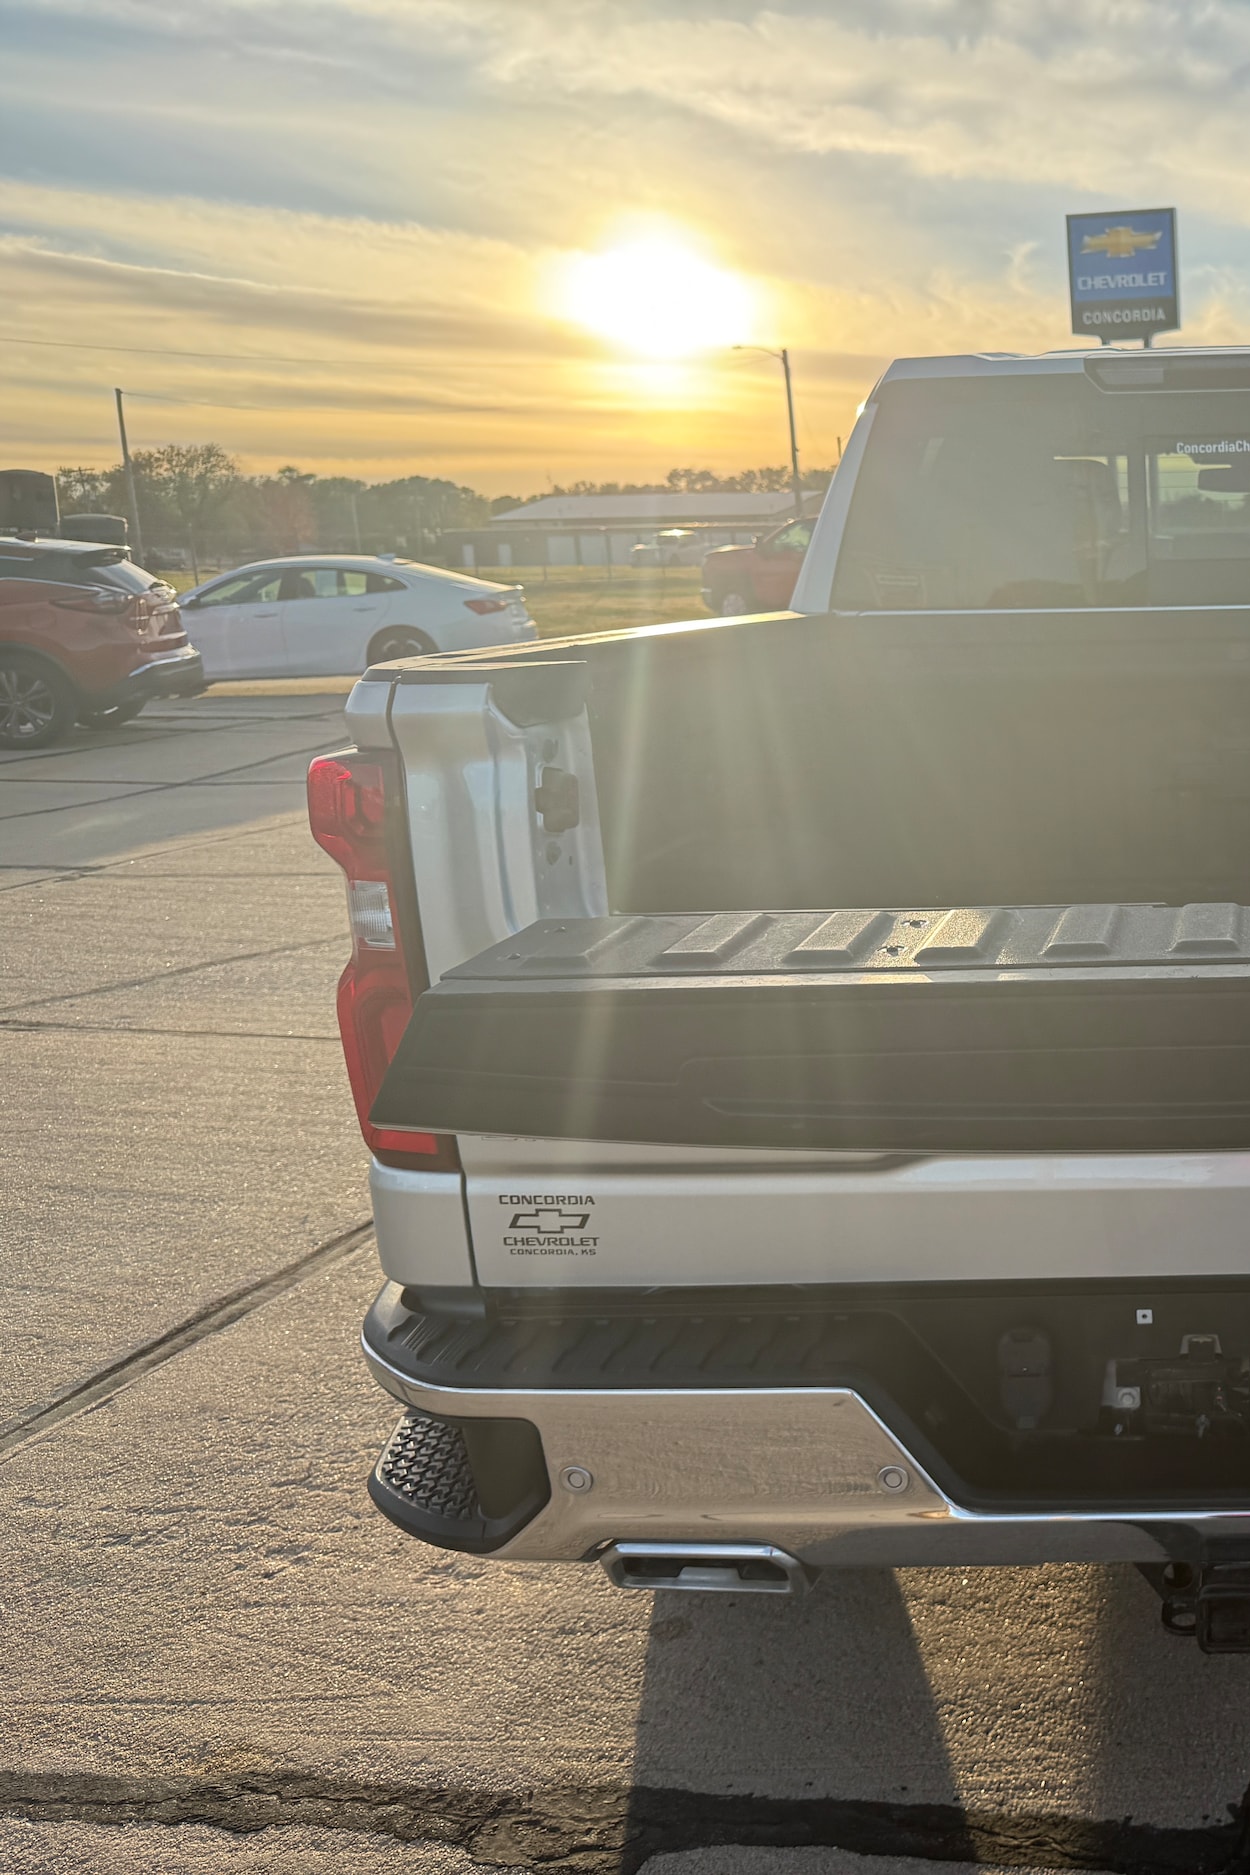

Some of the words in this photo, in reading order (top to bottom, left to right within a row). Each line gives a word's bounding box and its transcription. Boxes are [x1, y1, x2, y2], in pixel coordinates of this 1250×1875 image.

[1077, 271, 1167, 290] CHEVROLET
[1082, 307, 1166, 325] CONCORDIA
[499, 1195, 595, 1205] CONCORDIA
[503, 1237, 599, 1247] CHEVROLET
[510, 1248, 578, 1256] CONCORDIA,
[581, 1248, 596, 1256] KS
